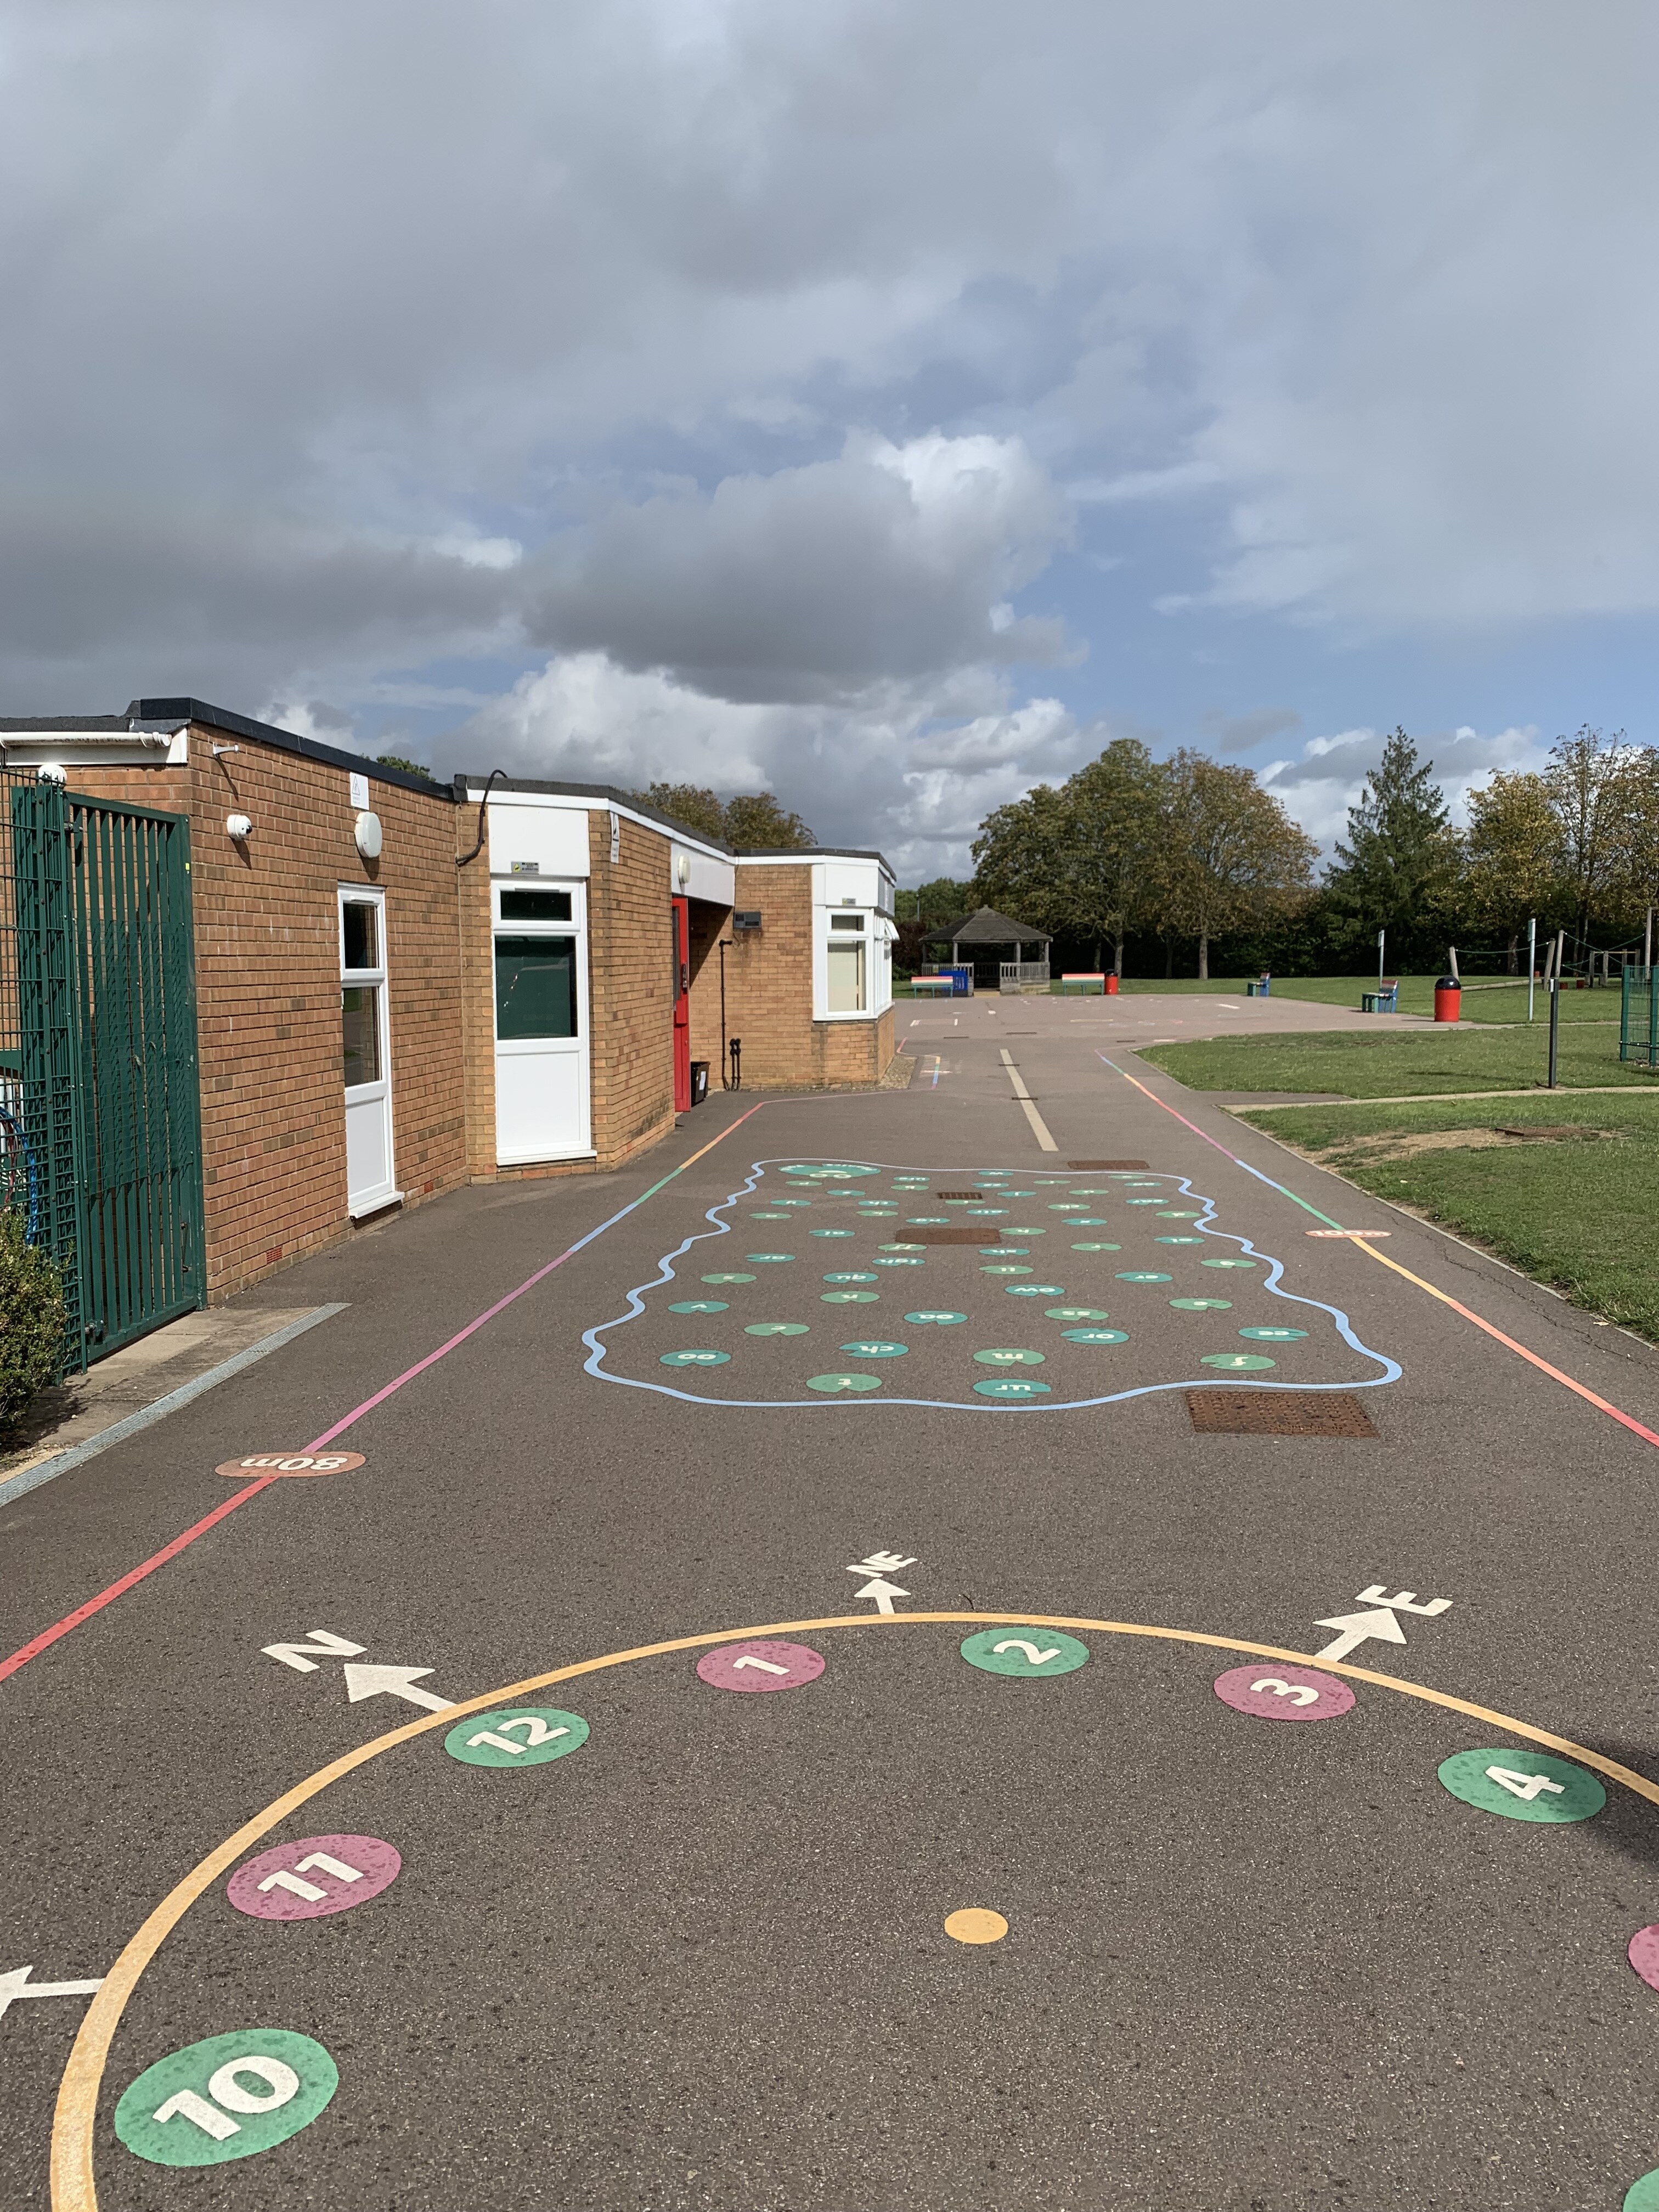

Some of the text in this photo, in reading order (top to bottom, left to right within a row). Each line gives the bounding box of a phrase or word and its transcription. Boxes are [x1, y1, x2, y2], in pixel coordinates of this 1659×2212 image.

[1229, 1357, 1249, 1366] f
[240, 1457, 348, 1470] 80m
[846, 1550, 918, 1578] NE
[1355, 1584, 1453, 1616] E
[261, 1629, 368, 1673] N
[733, 1655, 790, 1675] 1
[993, 1639, 1062, 1664] 2
[1250, 1678, 1319, 1706] 3
[466, 1717, 570, 1754] 12
[1485, 1765, 1565, 1801] 4
[257, 1852, 364, 1902] 11
[153, 2055, 300, 2141] 10
